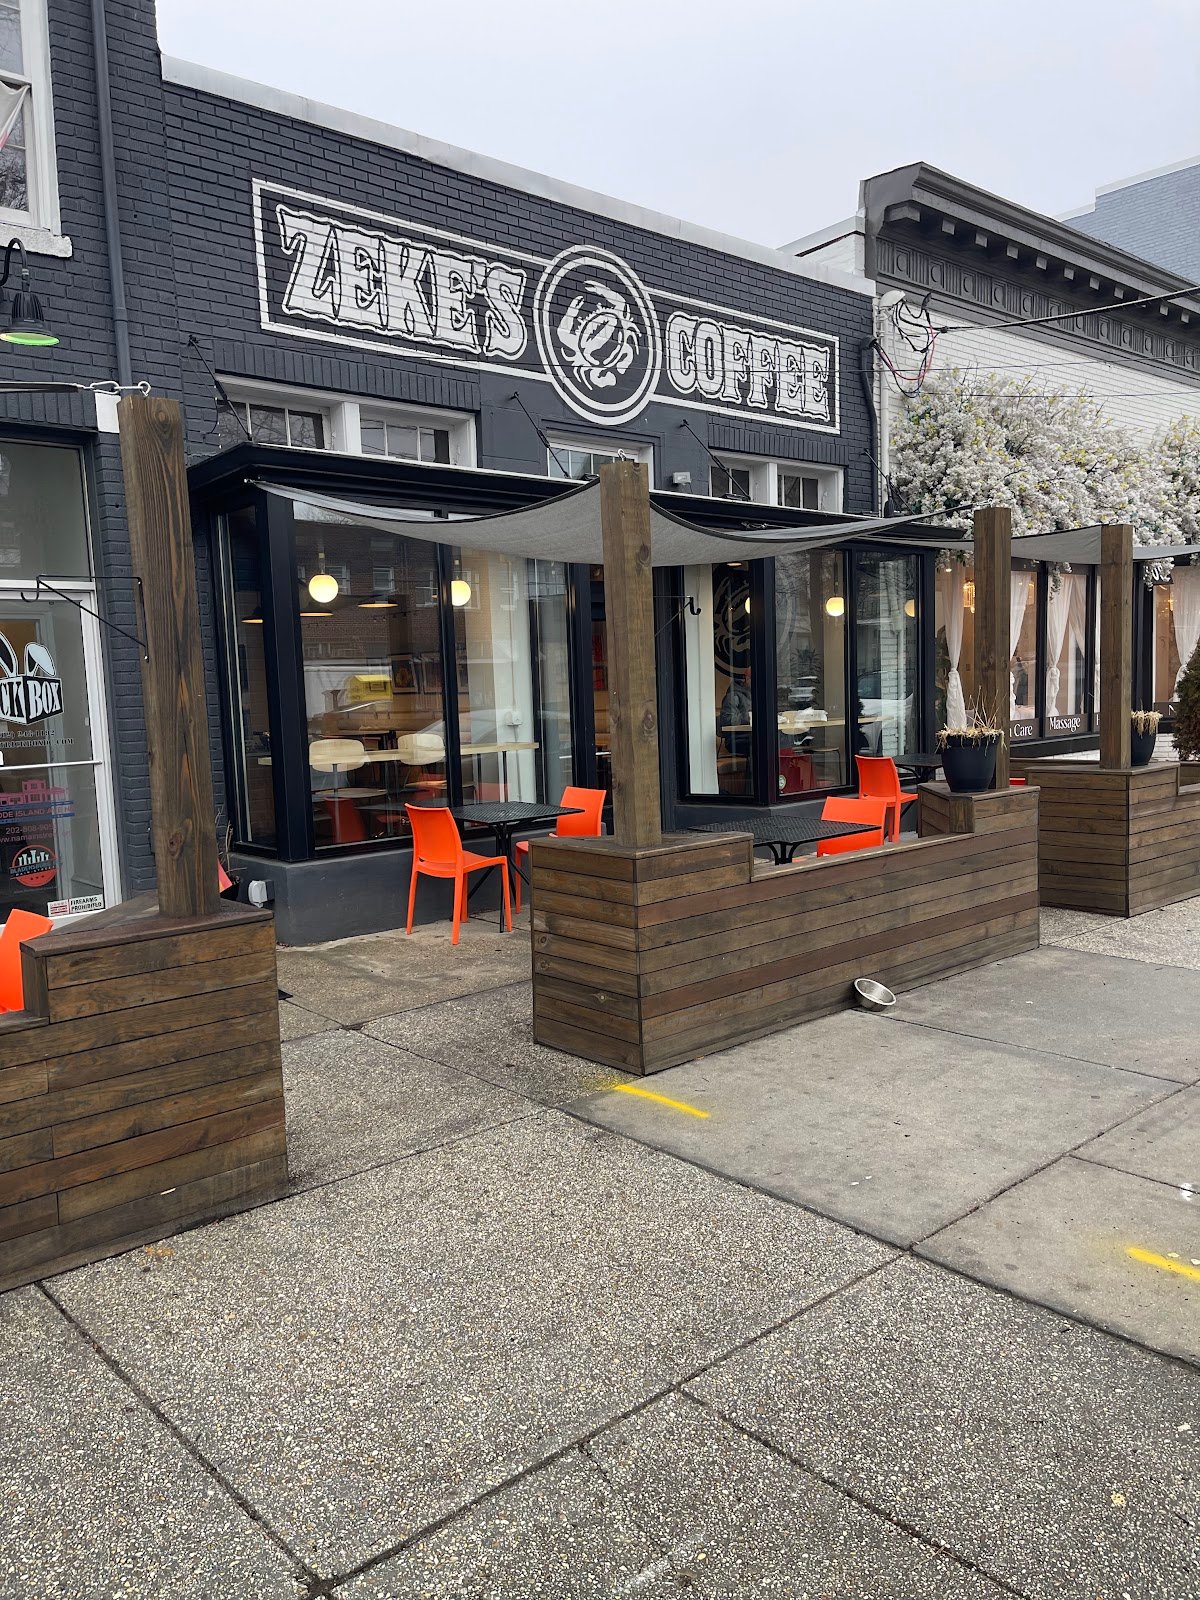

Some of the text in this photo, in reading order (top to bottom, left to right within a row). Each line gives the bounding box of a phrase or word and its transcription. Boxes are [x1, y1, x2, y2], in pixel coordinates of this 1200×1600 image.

[276, 204, 830, 422] ZEKE'S COFFEE
[27, 680, 61, 719] BOX
[1014, 723, 1033, 737] Care
[1049, 717, 1081, 733] Massage
[15, 807, 45, 818] ISLAND
[70, 896, 98, 906] FIREARMS
[71, 901, 102, 911] PROHIBITED
